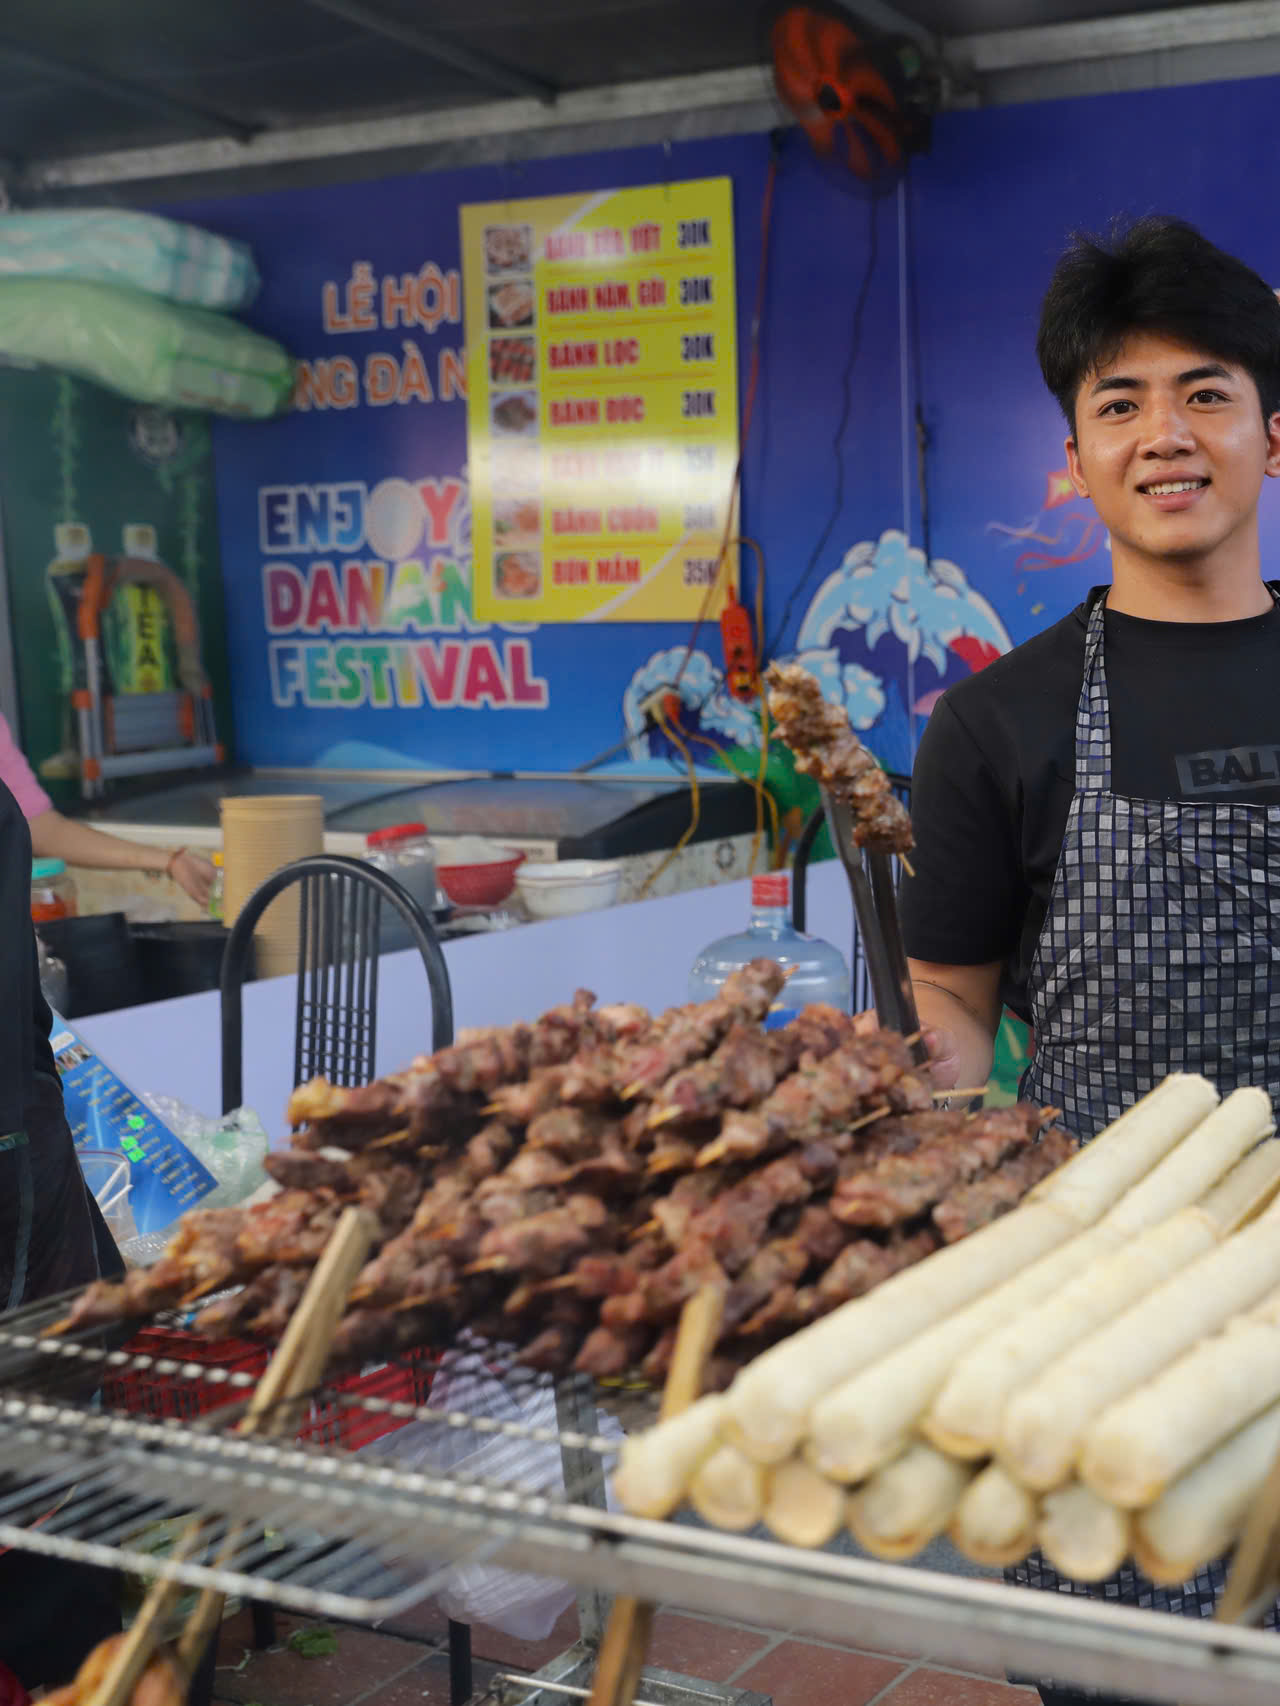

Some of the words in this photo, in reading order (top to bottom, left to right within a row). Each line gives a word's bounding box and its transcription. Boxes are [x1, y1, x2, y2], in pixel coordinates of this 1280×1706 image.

[678, 220, 710, 247] 30K
[322, 260, 377, 334] LỄ
[382, 261, 461, 334] HỘI
[680, 277, 712, 305] 30K
[363, 340, 432, 407] ĐÀ
[682, 333, 714, 361] 30K
[683, 391, 715, 418] 30K
[259, 477, 468, 561] ENJOY
[262, 555, 486, 635] DANAN
[269, 638, 549, 709] FESTIVAL
